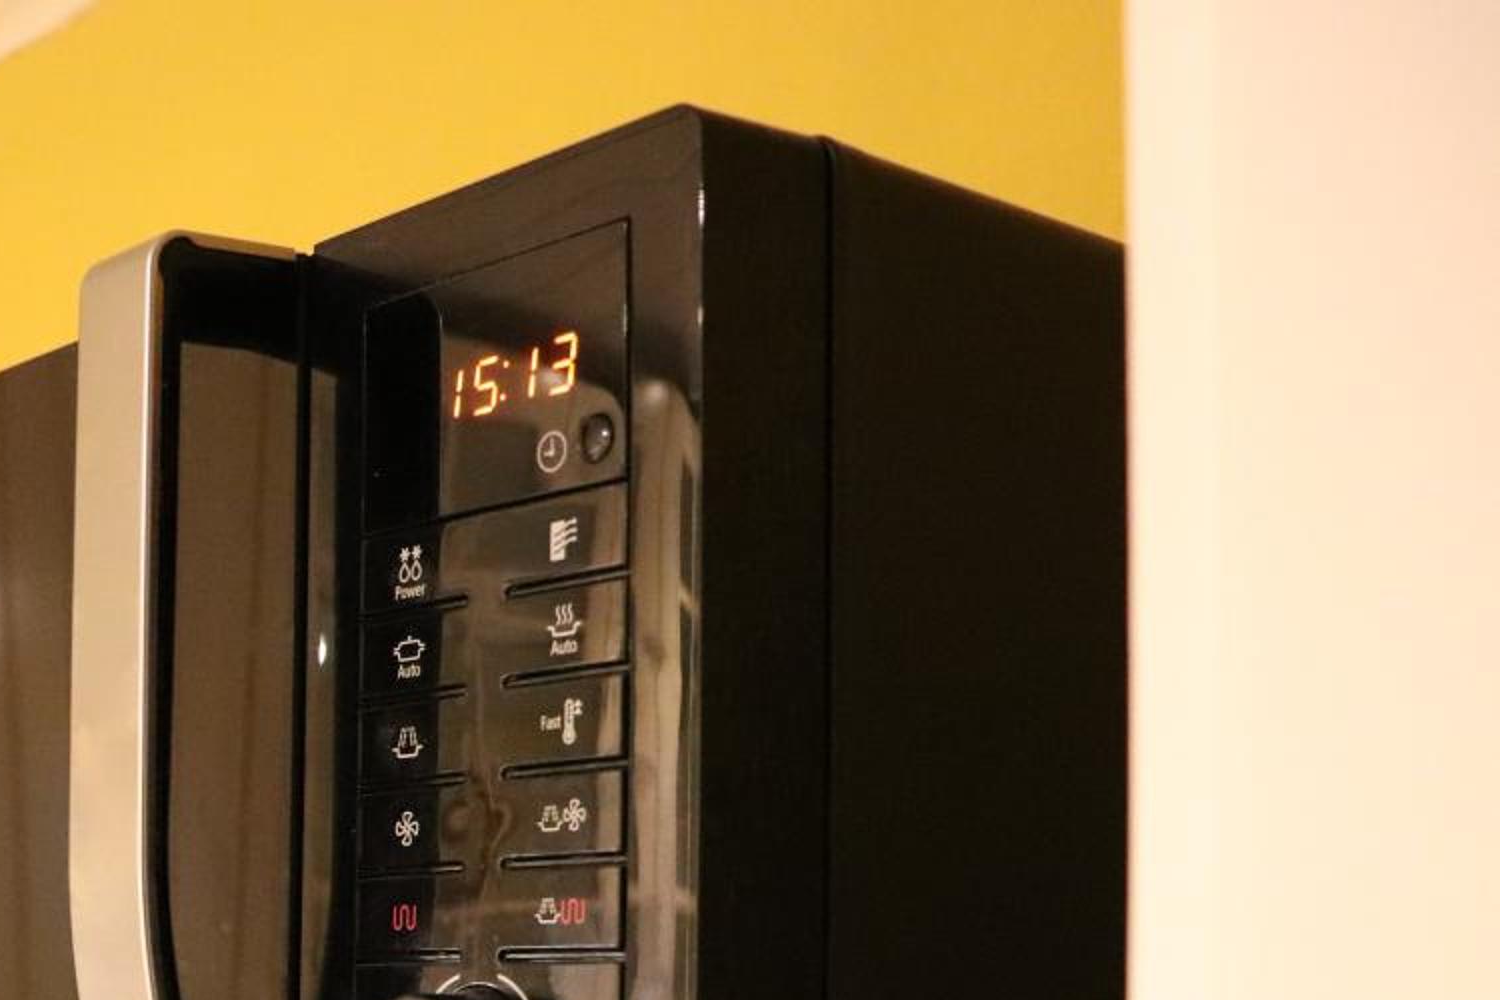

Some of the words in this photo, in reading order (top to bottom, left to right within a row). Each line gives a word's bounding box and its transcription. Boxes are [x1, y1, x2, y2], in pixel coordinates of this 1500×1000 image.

[451, 331, 580, 419] 15:13
[395, 582, 426, 600] Power
[550, 638, 579, 655] Auto
[397, 662, 422, 679] Auto
[540, 714, 562, 732] Fast
